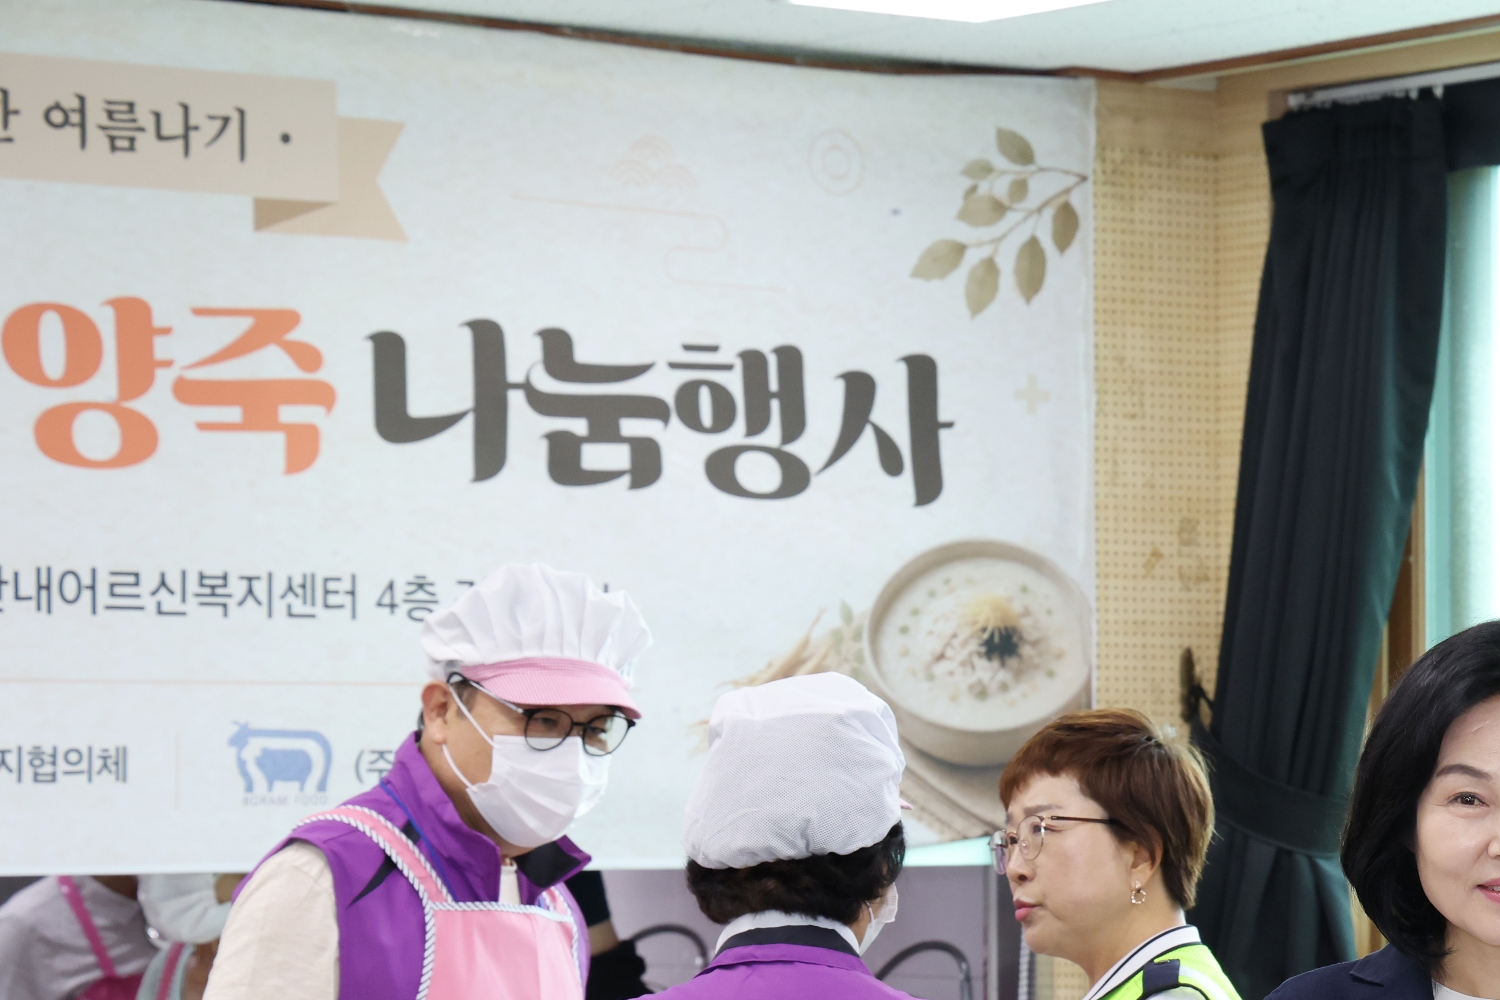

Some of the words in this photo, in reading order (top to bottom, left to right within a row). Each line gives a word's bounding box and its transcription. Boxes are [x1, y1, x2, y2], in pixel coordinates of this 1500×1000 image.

[43, 93, 247, 163] 여름나기
[2, 295, 337, 476] 양죽
[365, 318, 955, 509] 나눔행사
[0, 564, 358, 621] 내어르신복지센터
[375, 575, 440, 622] 4층
[0, 746, 128, 783] 지협의체
